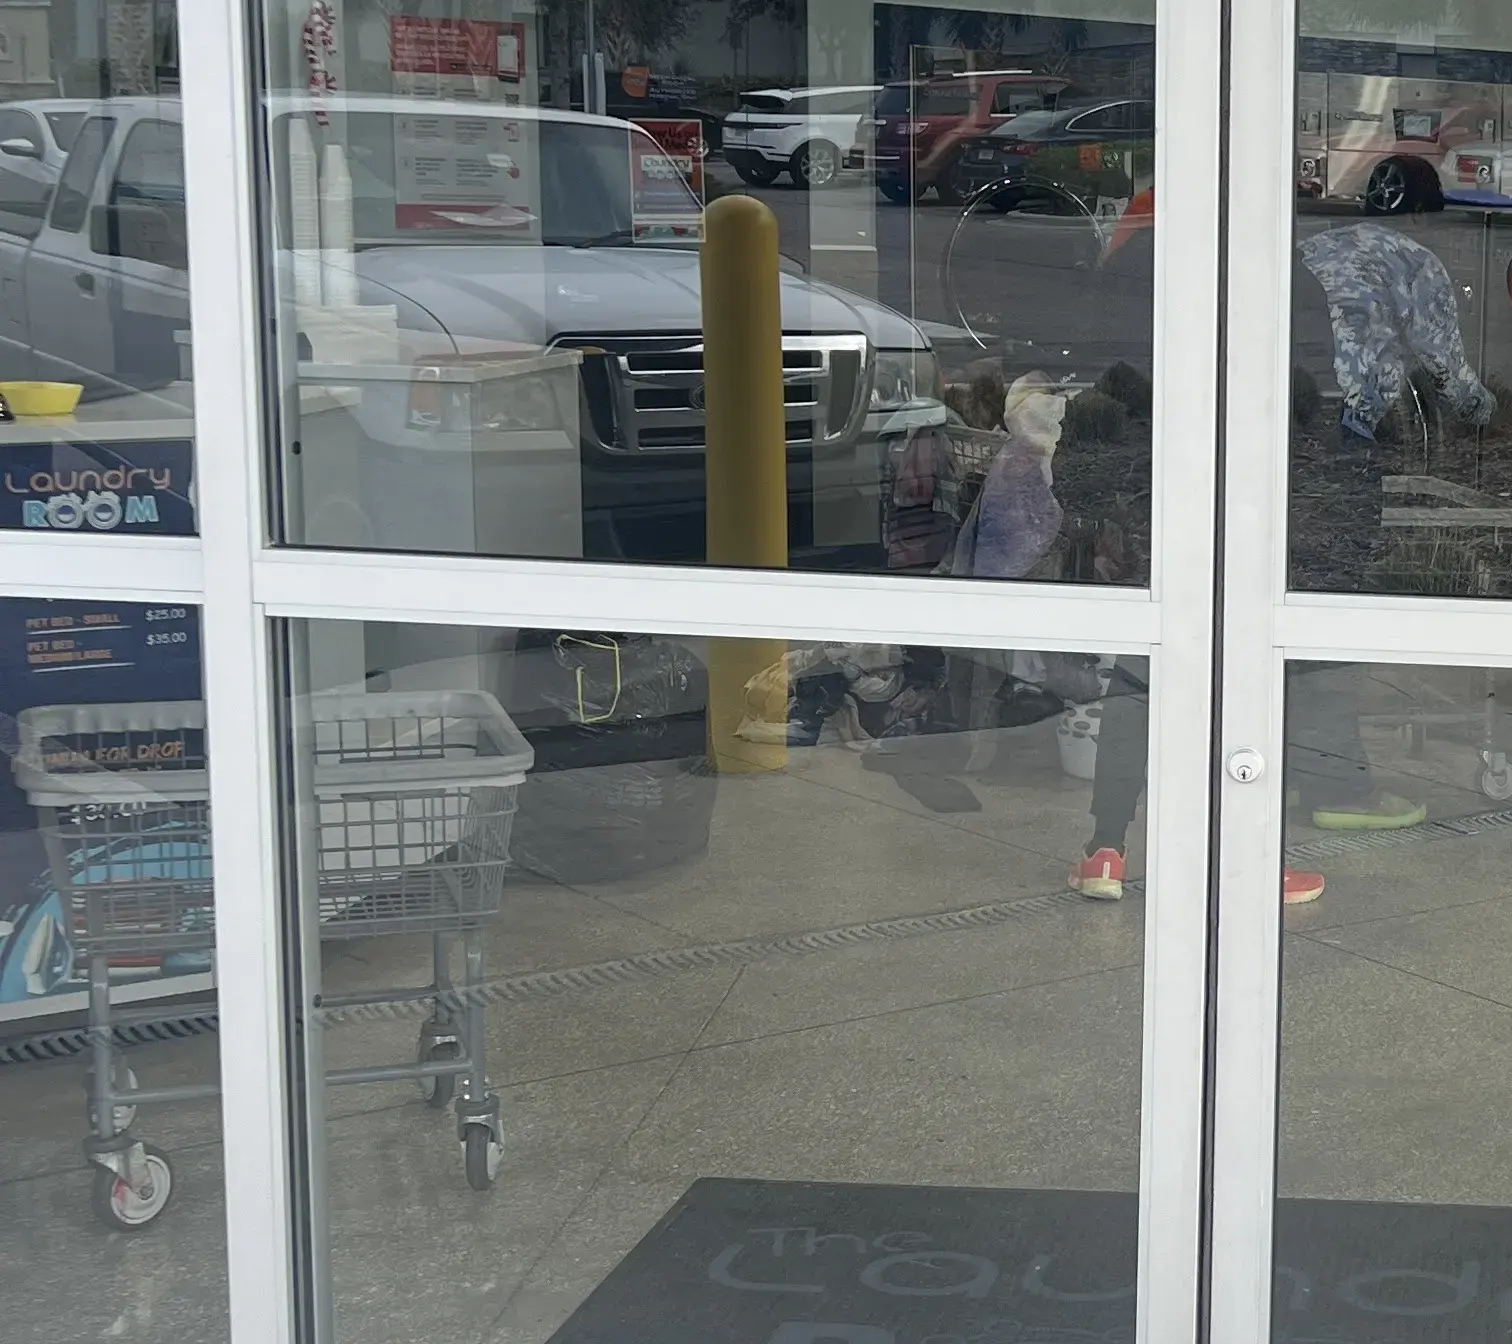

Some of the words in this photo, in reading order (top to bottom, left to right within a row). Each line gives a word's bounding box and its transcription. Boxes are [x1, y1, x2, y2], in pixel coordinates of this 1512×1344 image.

[4, 465, 171, 494] Laundry
[22, 493, 160, 530] ROOM
[145, 608, 187, 622] $25.00
[146, 632, 188, 646] $35.00
